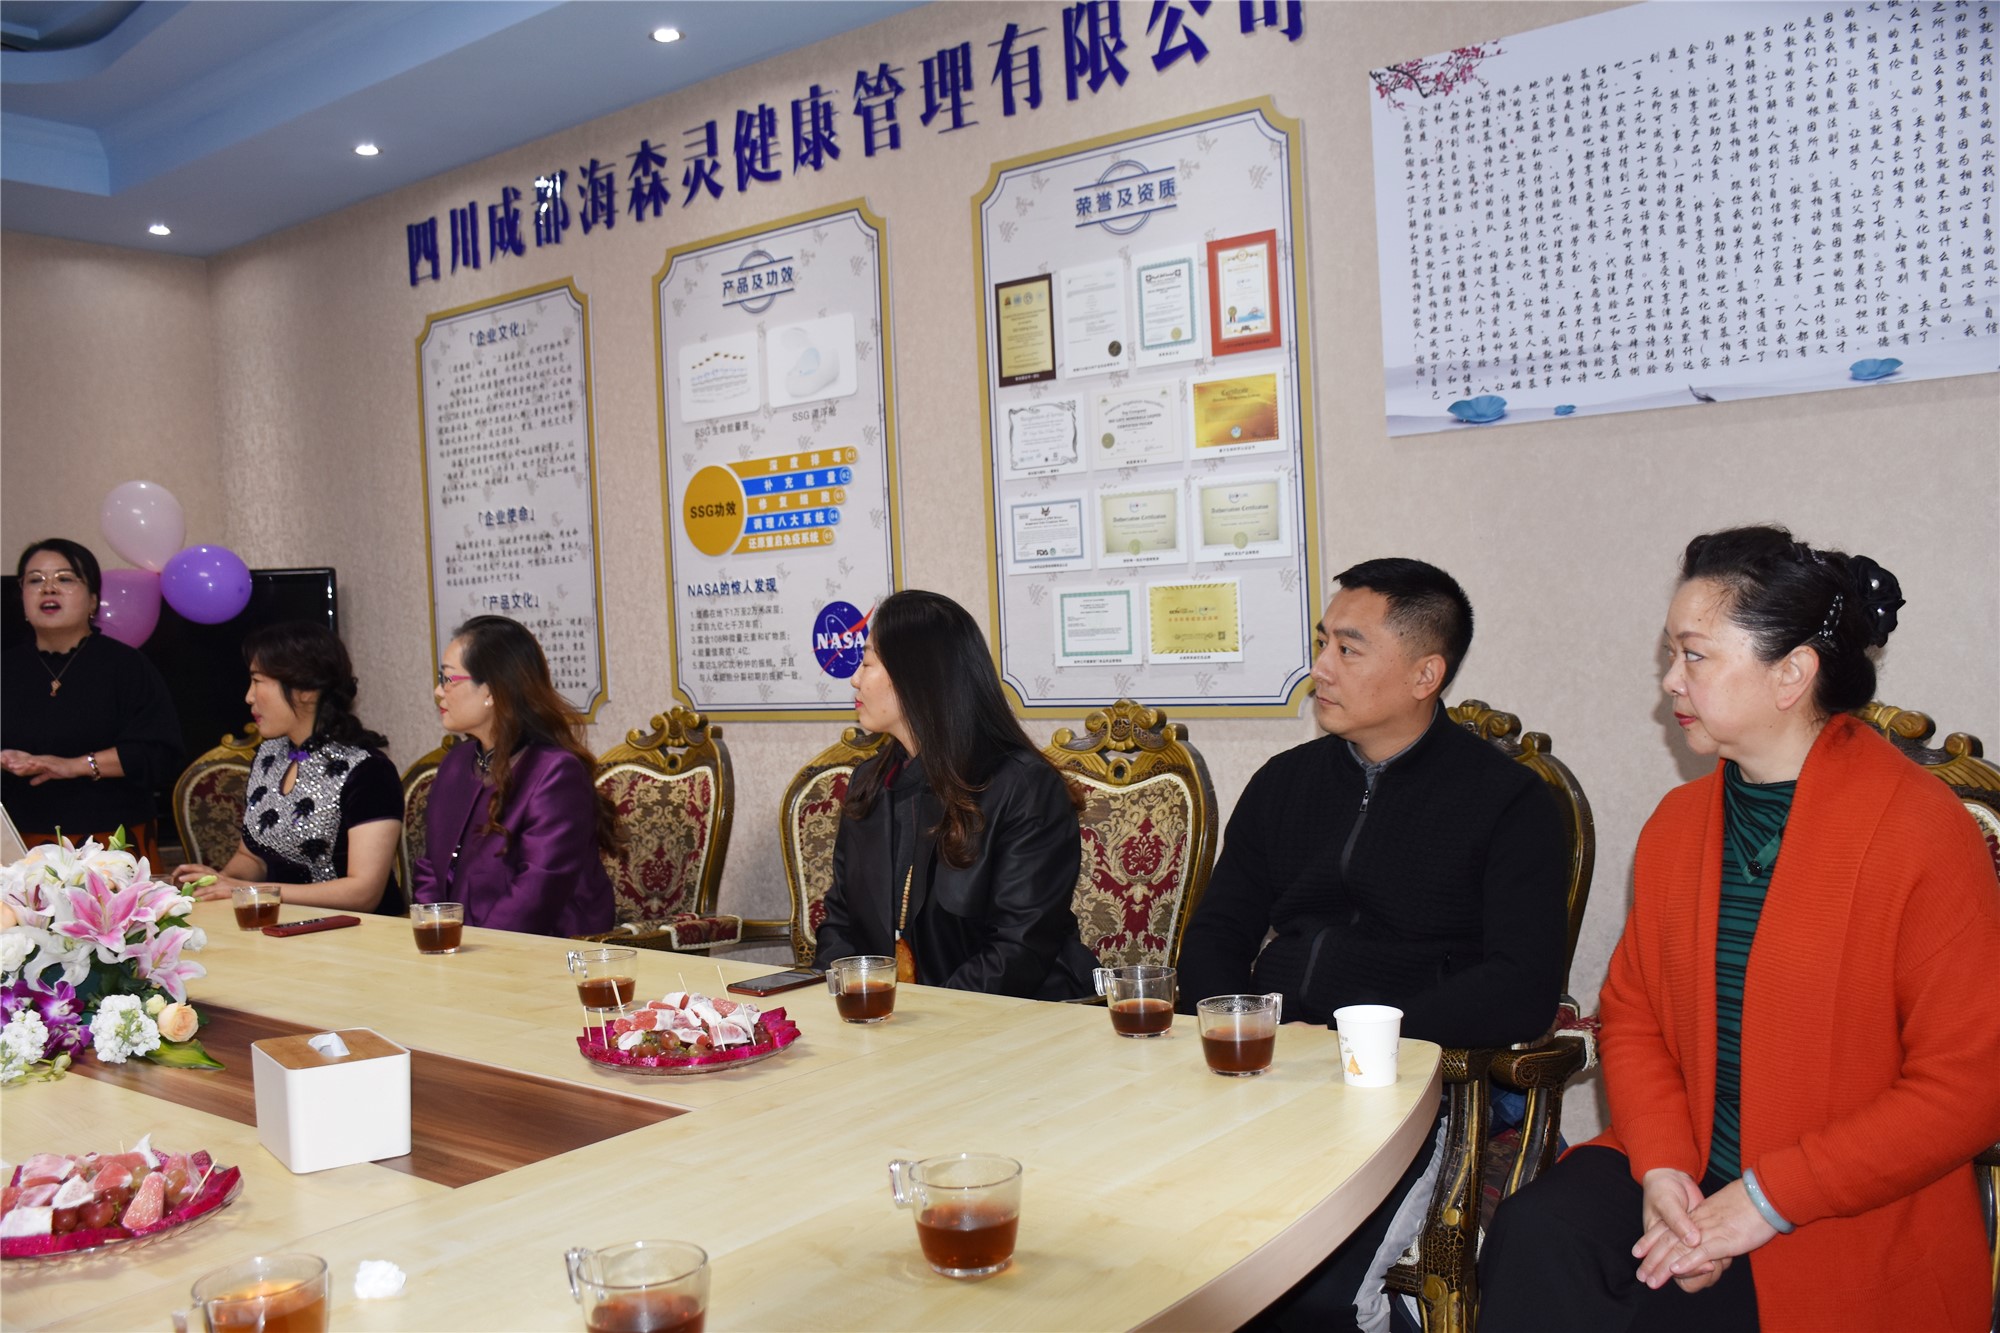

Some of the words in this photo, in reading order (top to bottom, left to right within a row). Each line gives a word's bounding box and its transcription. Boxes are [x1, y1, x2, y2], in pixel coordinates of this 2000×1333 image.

[1075, 177, 1176, 217] 荣誉及资质
[722, 266, 794, 297] 产品及功效
[792, 410, 810, 422] SSG
[769, 450, 842, 471] 深度排毒
[847, 450, 856, 460] 01
[764, 470, 837, 491] 补充能量
[842, 471, 851, 480] 02
[690, 501, 737, 519] SSG功效
[758, 490, 831, 510] 修复细胞
[753, 509, 826, 531] 调理八大系统
[830, 512, 839, 522] 04
[748, 531, 820, 550] 还原重启免疫系统
[688, 577, 778, 597] NASA的惊人发现
[816, 630, 867, 650] NASA
